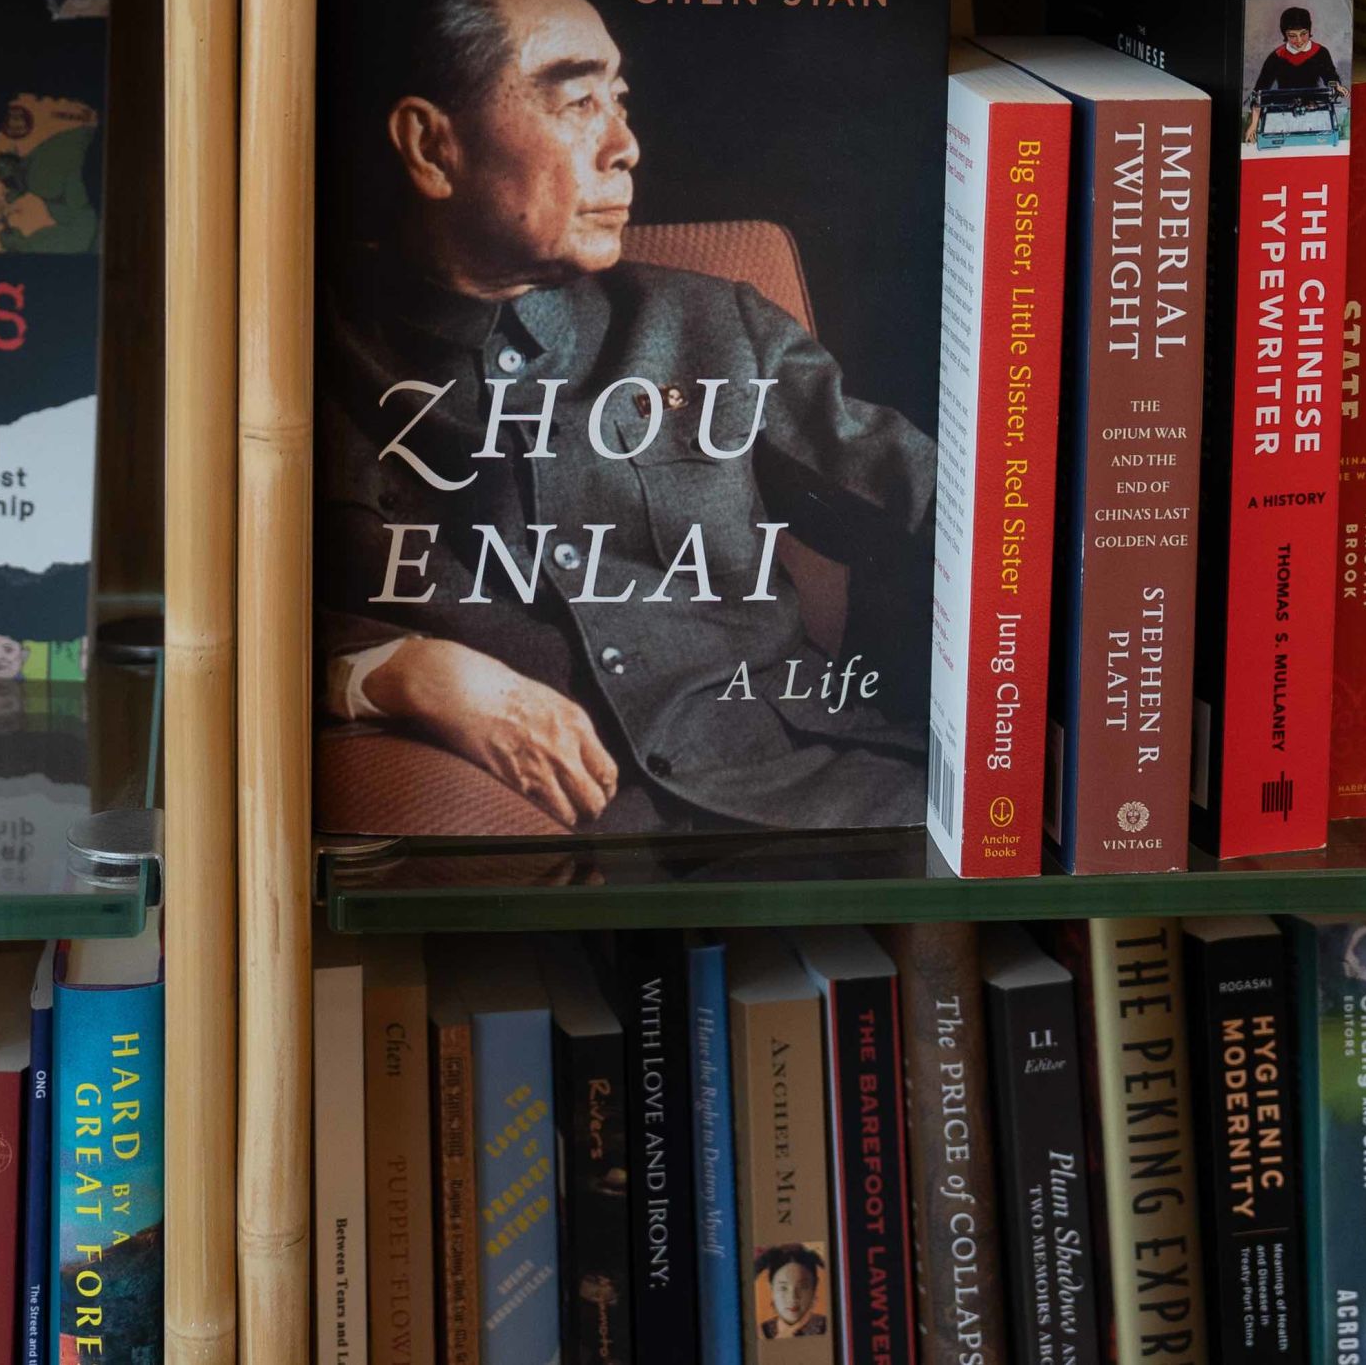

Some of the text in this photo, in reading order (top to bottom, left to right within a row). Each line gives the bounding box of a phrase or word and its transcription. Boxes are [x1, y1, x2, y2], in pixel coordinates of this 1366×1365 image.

[1108, 123, 1145, 360] TWILIGHT
[1154, 124, 1192, 358] IMPERIAL
[1254, 185, 1287, 456] TYPEWRITER
[1294, 184, 1328, 454] THE CHINESE
[378, 376, 779, 491] ZHOU
[1000, 140, 1041, 594] Big Sister, Little Sister, Red Sister
[368, 522, 789, 604] ENLAI
[717, 655, 880, 714] A Life
[986, 613, 1021, 771] Jung Chang
[75, 1082, 103, 1222] GREAT
[112, 1032, 140, 1246] HARD BY A
[1222, 1018, 1255, 1219] MODERNITY
[1252, 1016, 1284, 1189] HYGIENIC
